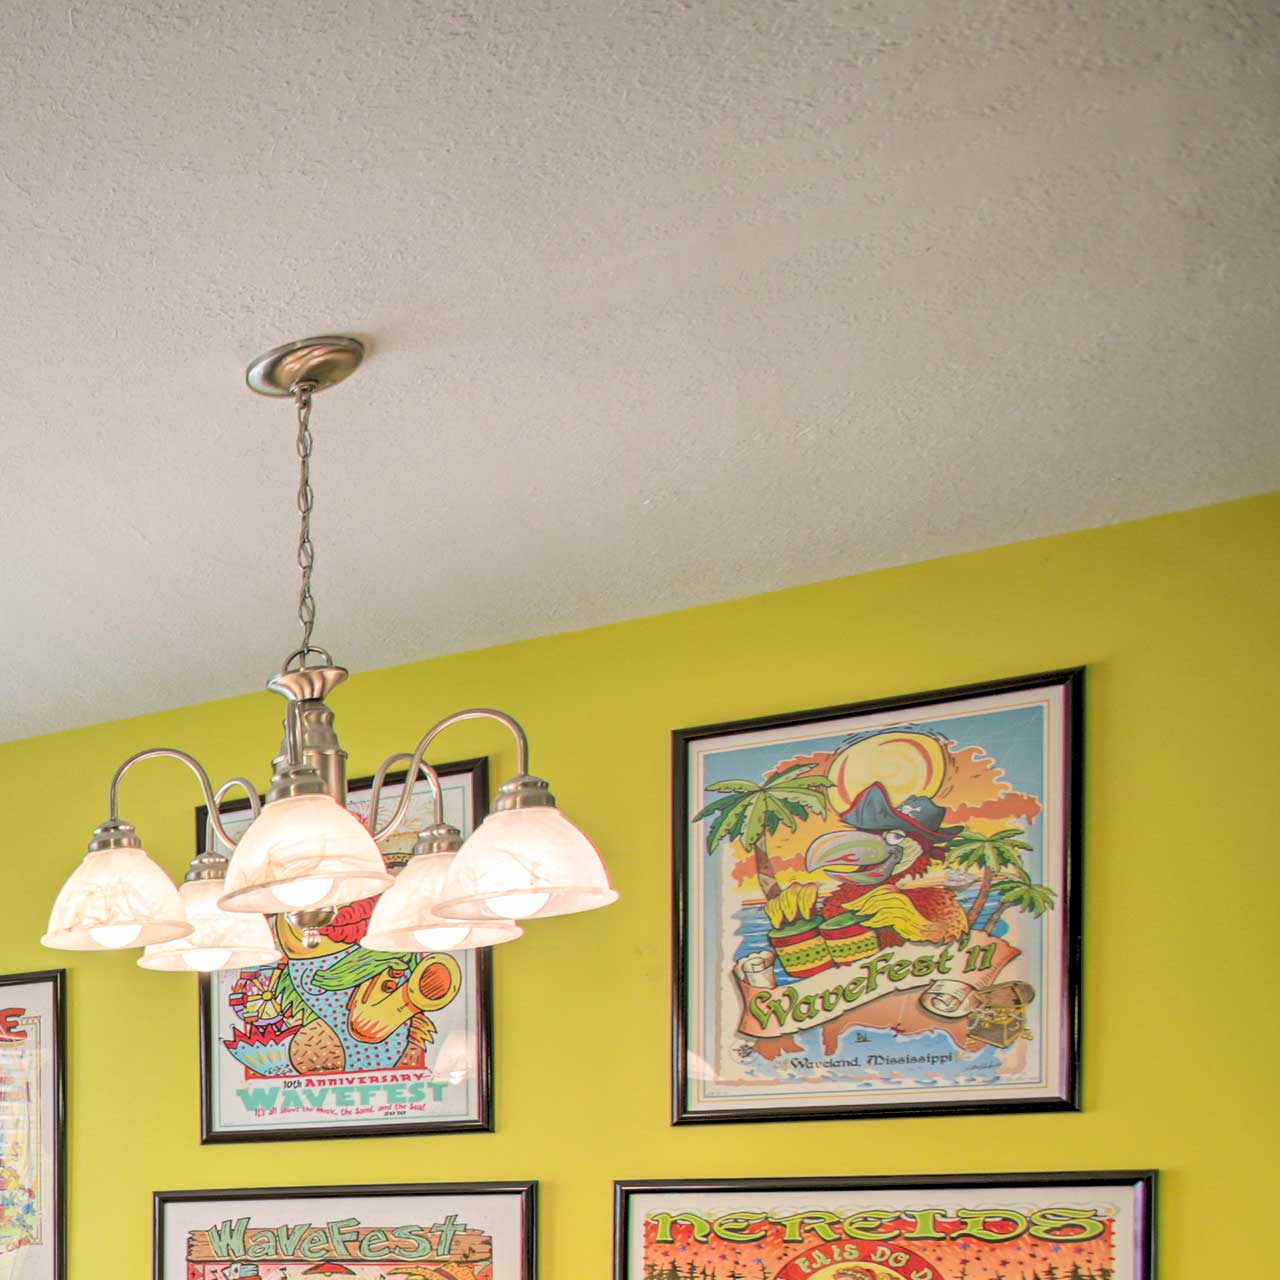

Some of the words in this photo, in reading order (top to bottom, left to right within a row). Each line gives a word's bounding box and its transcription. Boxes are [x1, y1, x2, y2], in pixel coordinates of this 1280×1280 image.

[867, 1051, 954, 1067] Mississippi
[236, 1081, 449, 1112] WAVEFEST
[649, 1207, 1107, 1245] NEREIDS
[870, 1245, 911, 1268] DO
